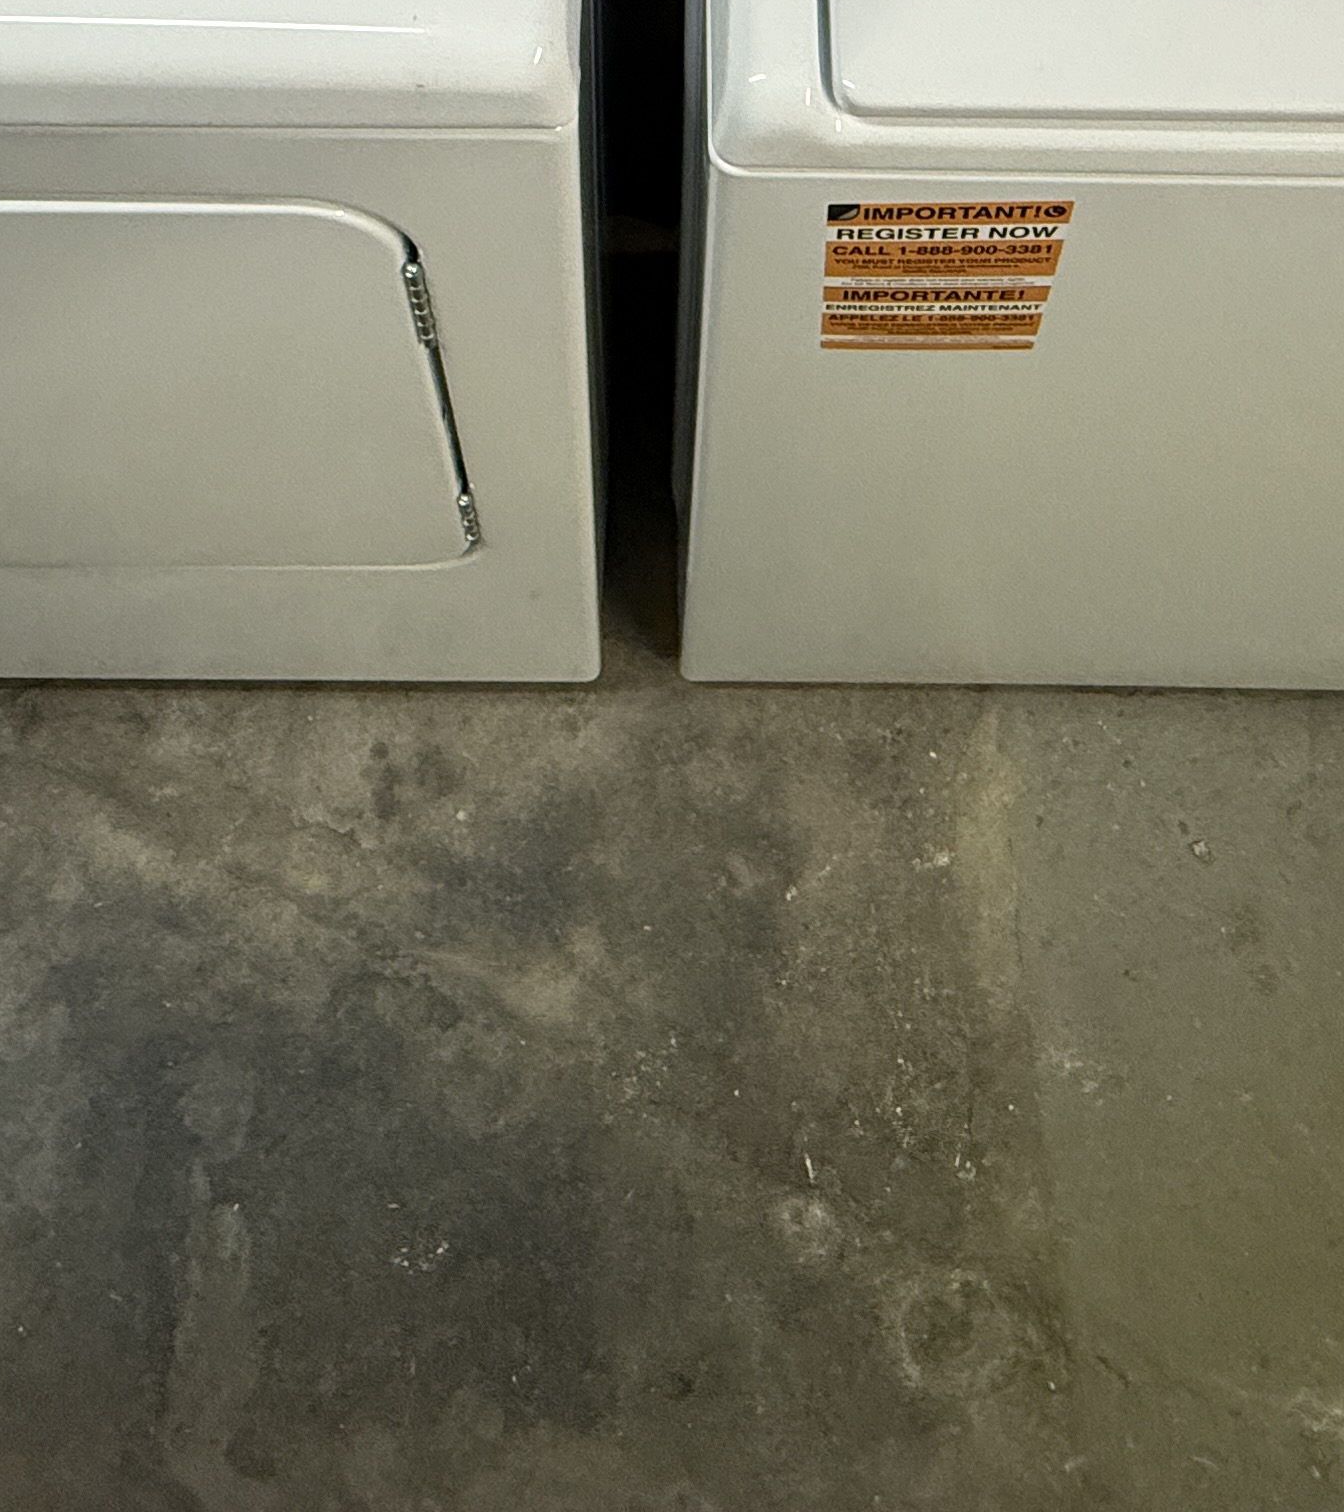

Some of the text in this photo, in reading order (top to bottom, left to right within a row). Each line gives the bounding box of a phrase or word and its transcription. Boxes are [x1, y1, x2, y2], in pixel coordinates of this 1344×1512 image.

[863, 205, 1042, 221] IMPORTANT!
[836, 226, 1059, 240] REGISTER NOW
[832, 245, 891, 256] CALL
[843, 289, 1025, 302] IMPORTANTE!
[825, 304, 1042, 312] ENREGISTREZ MAINTENANT
